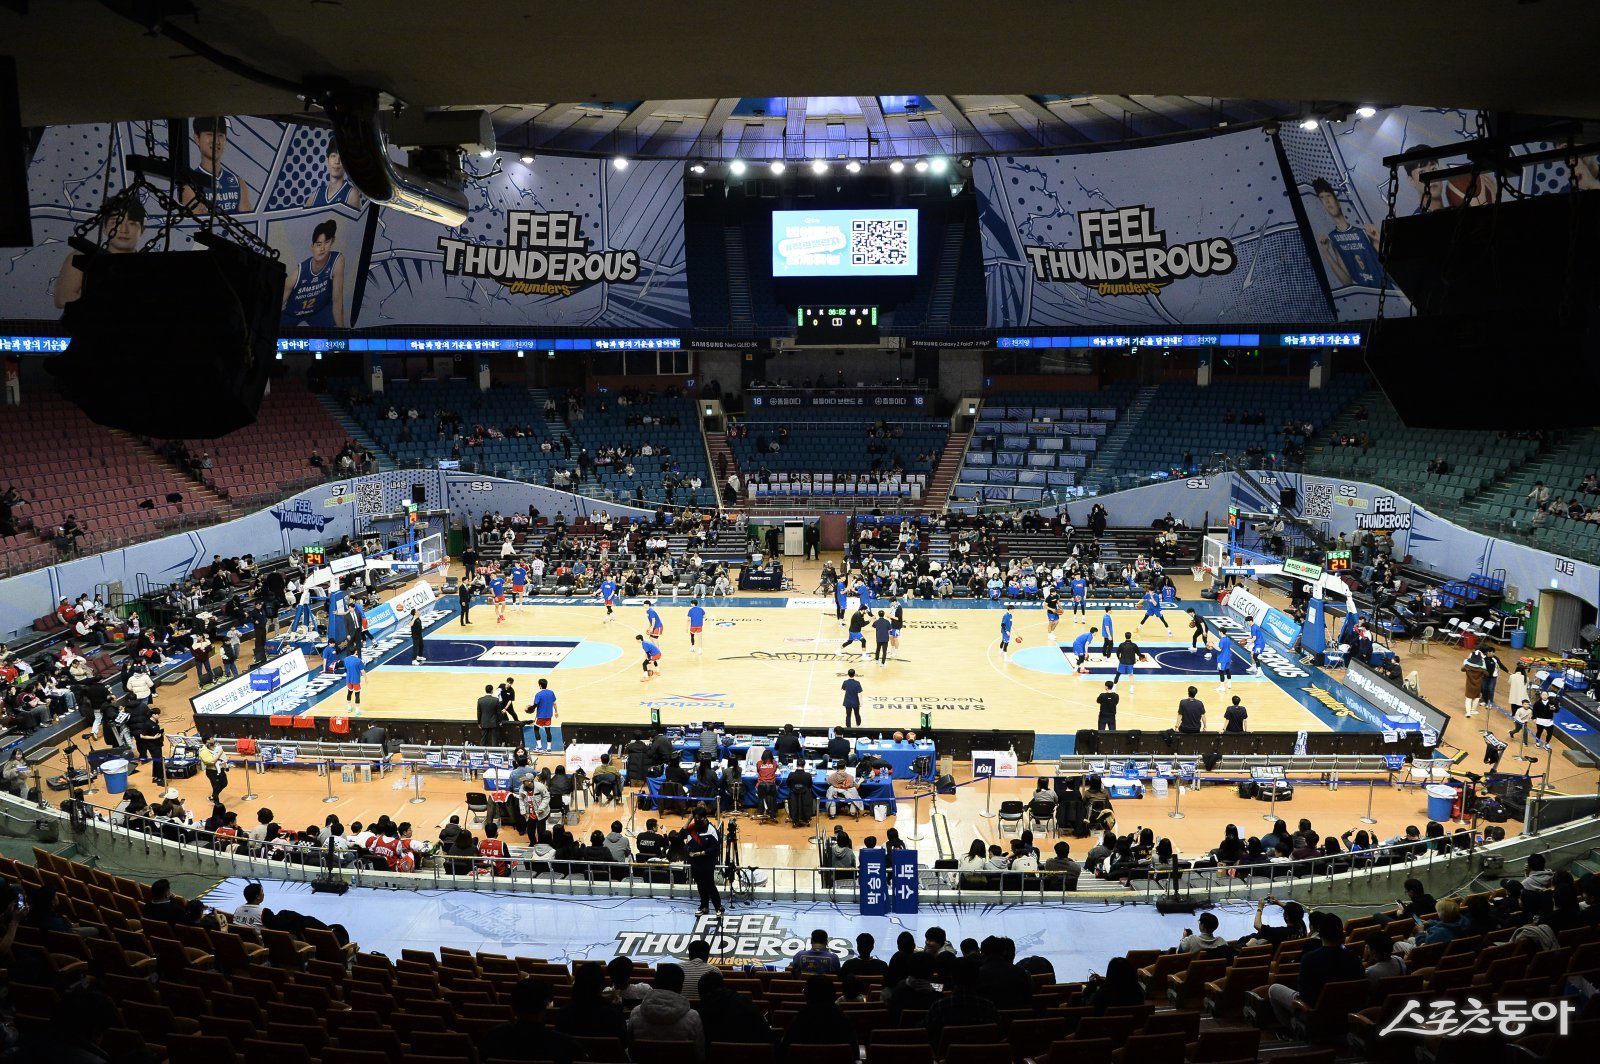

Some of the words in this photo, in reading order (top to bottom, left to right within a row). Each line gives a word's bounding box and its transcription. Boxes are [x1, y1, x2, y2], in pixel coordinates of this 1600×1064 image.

[508, 211, 585, 248] FEEL
[1080, 207, 1162, 248] FEEL
[440, 238, 638, 282] THUNDEROUS
[1026, 239, 1233, 281] THUNDEROUS
[297, 279, 328, 295] SAMSUNG
[505, 280, 572, 297] thunders
[1096, 280, 1163, 296] thunders
[302, 298, 317, 310] 12
[22, 339, 41, 351] 땅의
[410, 340, 433, 350] 하늘과
[434, 340, 450, 350] 땅의
[451, 340, 473, 350] 기운을
[595, 340, 617, 350] 하늘과
[618, 340, 633, 350] 땅의
[633, 340, 655, 349] 기운을
[691, 340, 724, 348] SAMSUNG
[938, 340, 957, 348] Galaxy
[1093, 336, 1114, 347] 하늘과
[1115, 336, 1130, 347] 땅의
[1131, 336, 1154, 347] 기운을
[1284, 335, 1307, 345] 하늘과
[1308, 335, 1325, 345] 땅의
[1326, 335, 1350, 345] 기운을
[687, 379, 695, 387] 17
[753, 397, 762, 405] 18
[914, 397, 924, 405] 18
[332, 485, 348, 496] S7
[471, 481, 493, 491] S8
[1186, 479, 1209, 489] S1
[1339, 485, 1357, 497] S2
[294, 499, 312, 513] FEEL
[1374, 497, 1396, 514] FEEL
[280, 509, 325, 527] THUNDEROUS
[1355, 513, 1411, 530] THUNDEROUS
[307, 553, 321, 564] 24
[1328, 551, 1350, 559] 36:52
[1331, 559, 1347, 570] 24
[1555, 558, 1575, 576] 내1문
[403, 589, 430, 613] LGE.COM
[1232, 595, 1261, 619] LGE.COM
[1267, 614, 1283, 627] POCARI
[1282, 622, 1296, 636] SWEAT
[200, 690, 239, 714] 라이프스타일
[639, 701, 737, 709] Reebok
[867, 862, 882, 905] 박승재
[897, 863, 915, 900] 박수
[694, 914, 782, 935] FEEL
